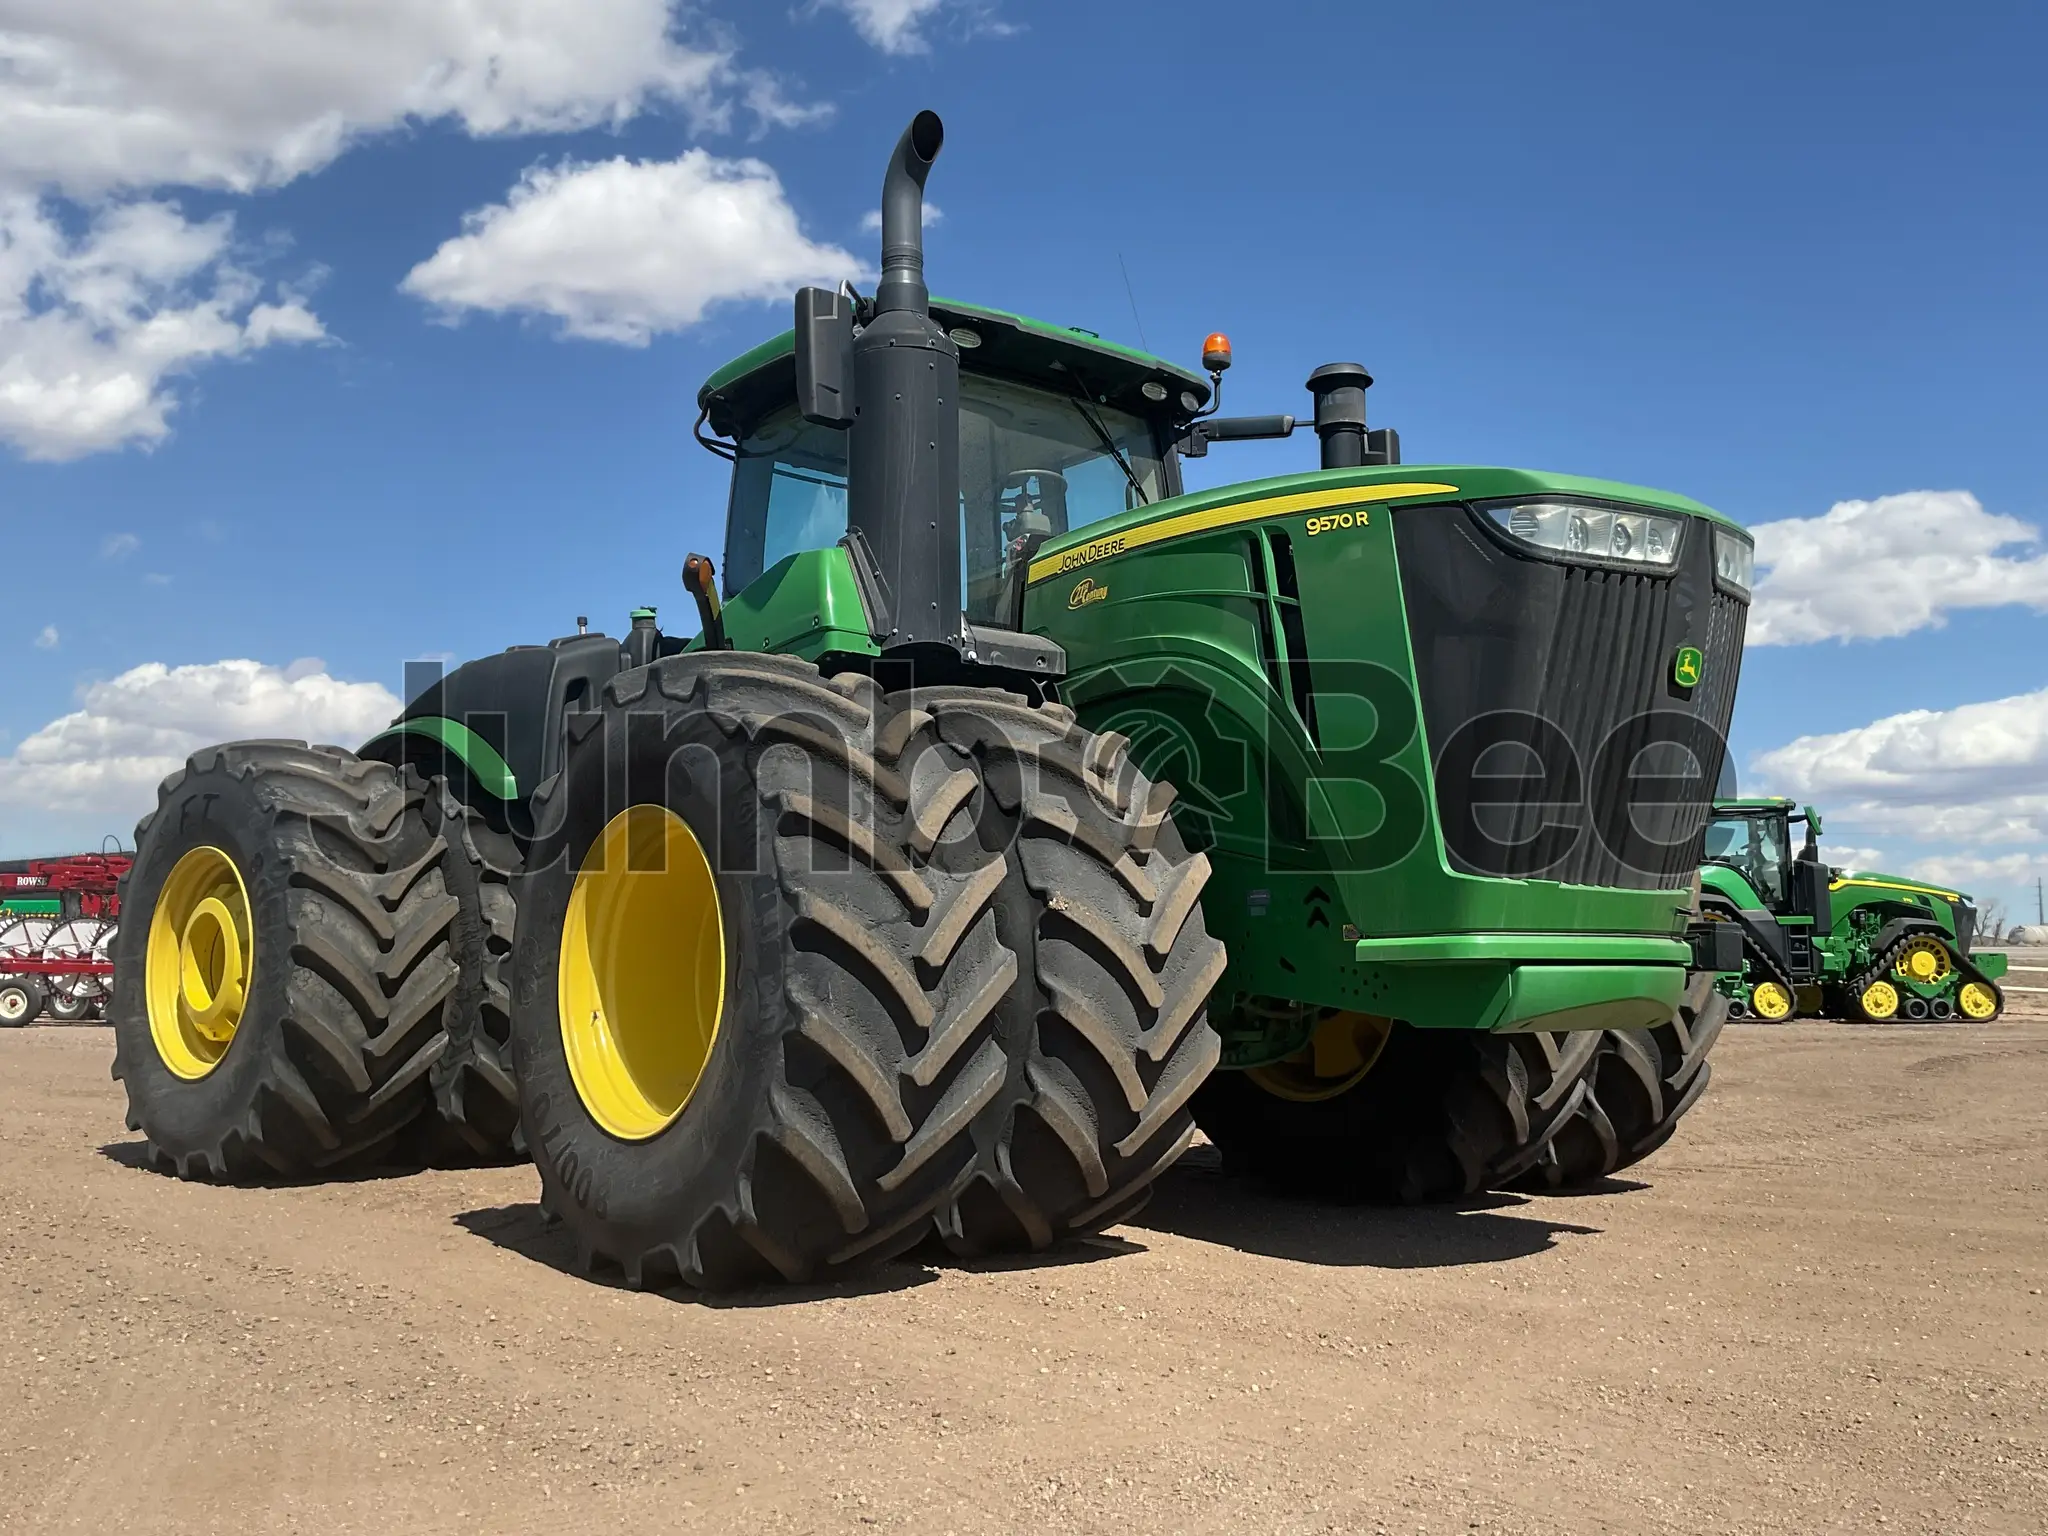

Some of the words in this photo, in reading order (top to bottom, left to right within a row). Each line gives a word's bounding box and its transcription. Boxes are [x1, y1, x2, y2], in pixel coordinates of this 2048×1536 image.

[1305, 512, 1353, 536] 9570
[1355, 510, 1370, 527] R
[1058, 549, 1087, 573] JOHN
[1087, 537, 1126, 561] DEERE
[16, 876, 48, 886] ROWSE
